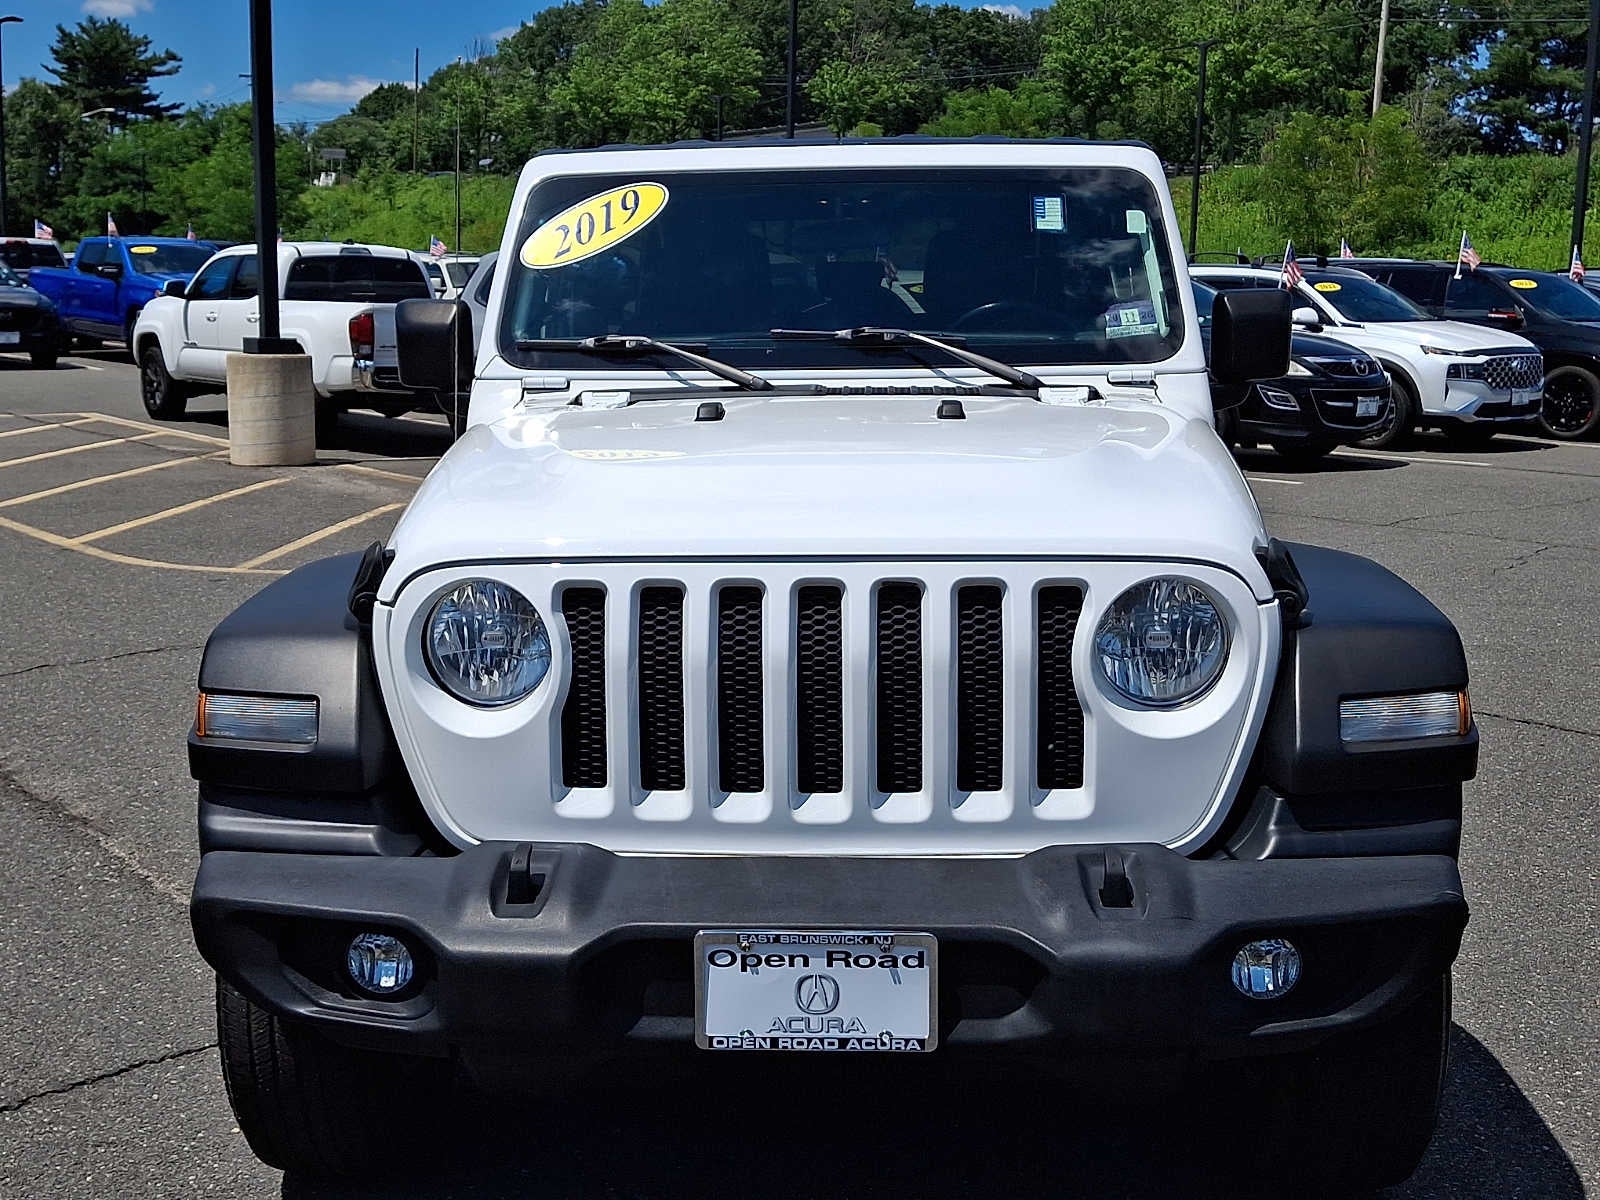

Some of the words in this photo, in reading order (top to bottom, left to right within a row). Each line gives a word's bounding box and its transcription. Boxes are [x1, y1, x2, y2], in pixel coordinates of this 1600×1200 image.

[554, 189, 640, 259] 2019
[739, 934, 776, 944] EAST
[873, 935, 892, 945] NJ
[707, 949, 810, 973] Open
[826, 950, 925, 969] Road
[765, 1016, 867, 1034] ACURA
[712, 1037, 770, 1049] OPEN
[778, 1037, 839, 1050] ROAD
[846, 1037, 921, 1051] ACURA
